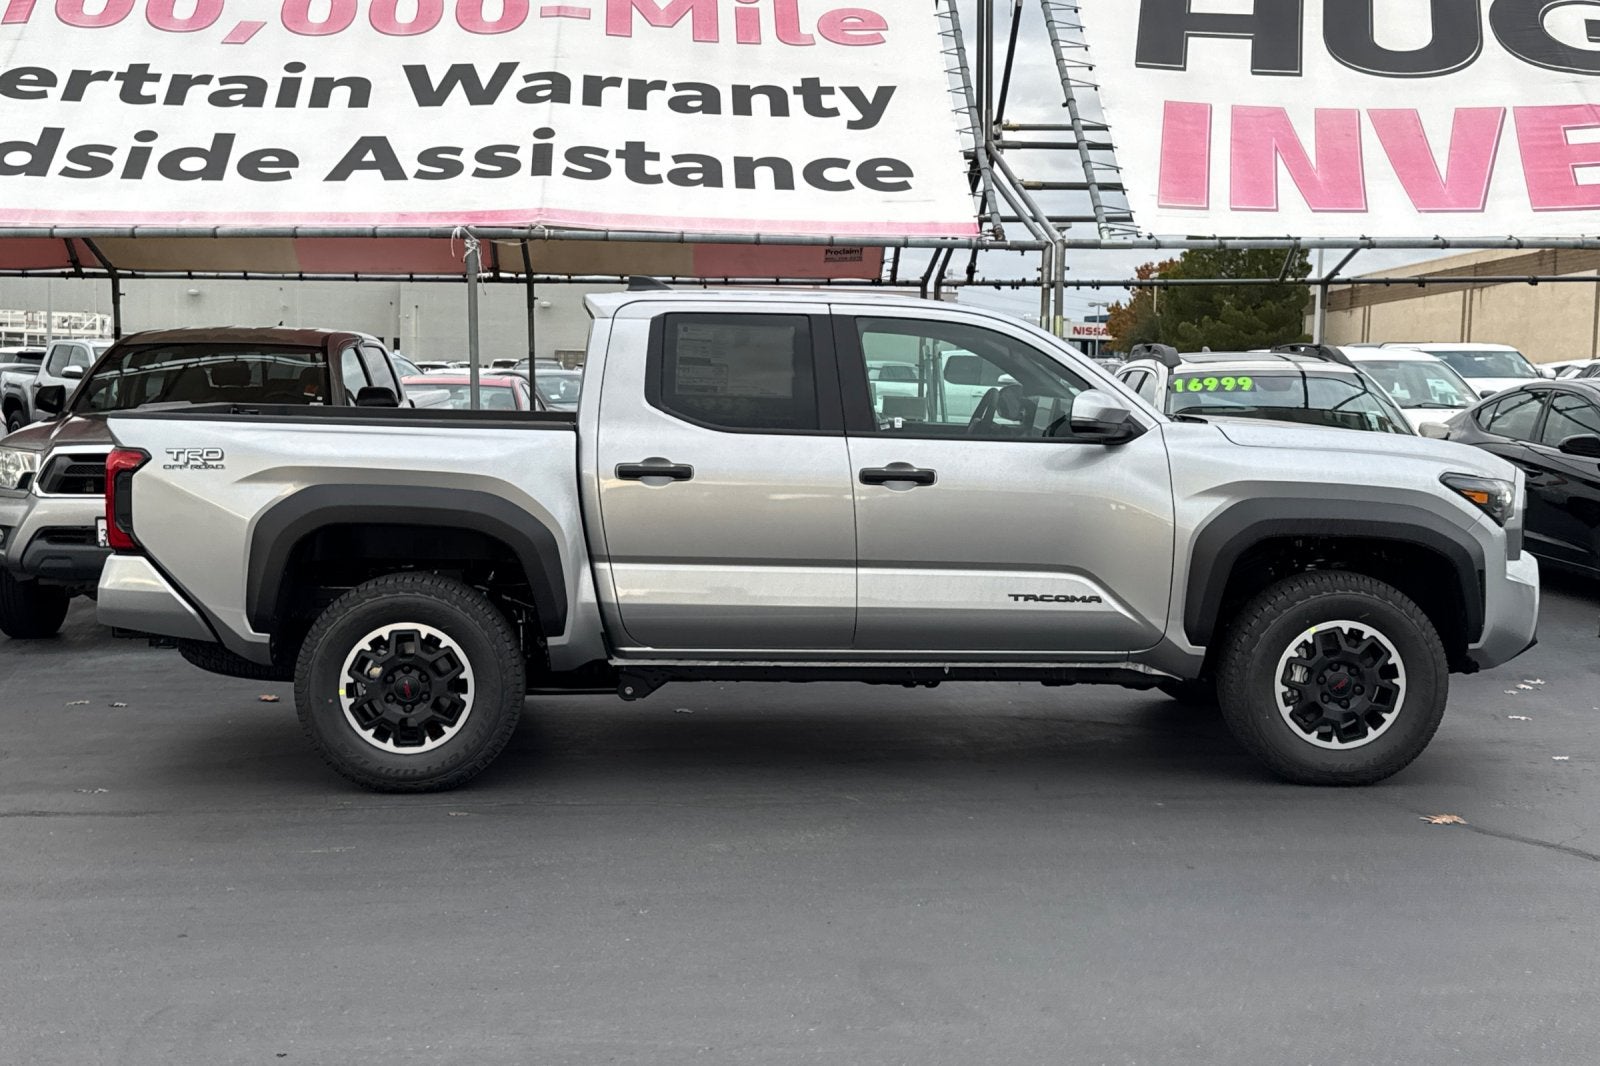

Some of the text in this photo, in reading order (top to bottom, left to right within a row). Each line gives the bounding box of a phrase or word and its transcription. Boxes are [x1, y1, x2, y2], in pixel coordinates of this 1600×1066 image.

[0, 61, 897, 130] ertrain Warranty
[0, 127, 914, 192] dside Assistance
[1158, 100, 1600, 213] INVE
[1072, 326, 1110, 336] NISSA
[1173, 376, 1253, 393] 16999
[165, 447, 224, 466] TRD
[1008, 593, 1102, 604] TACOMA
